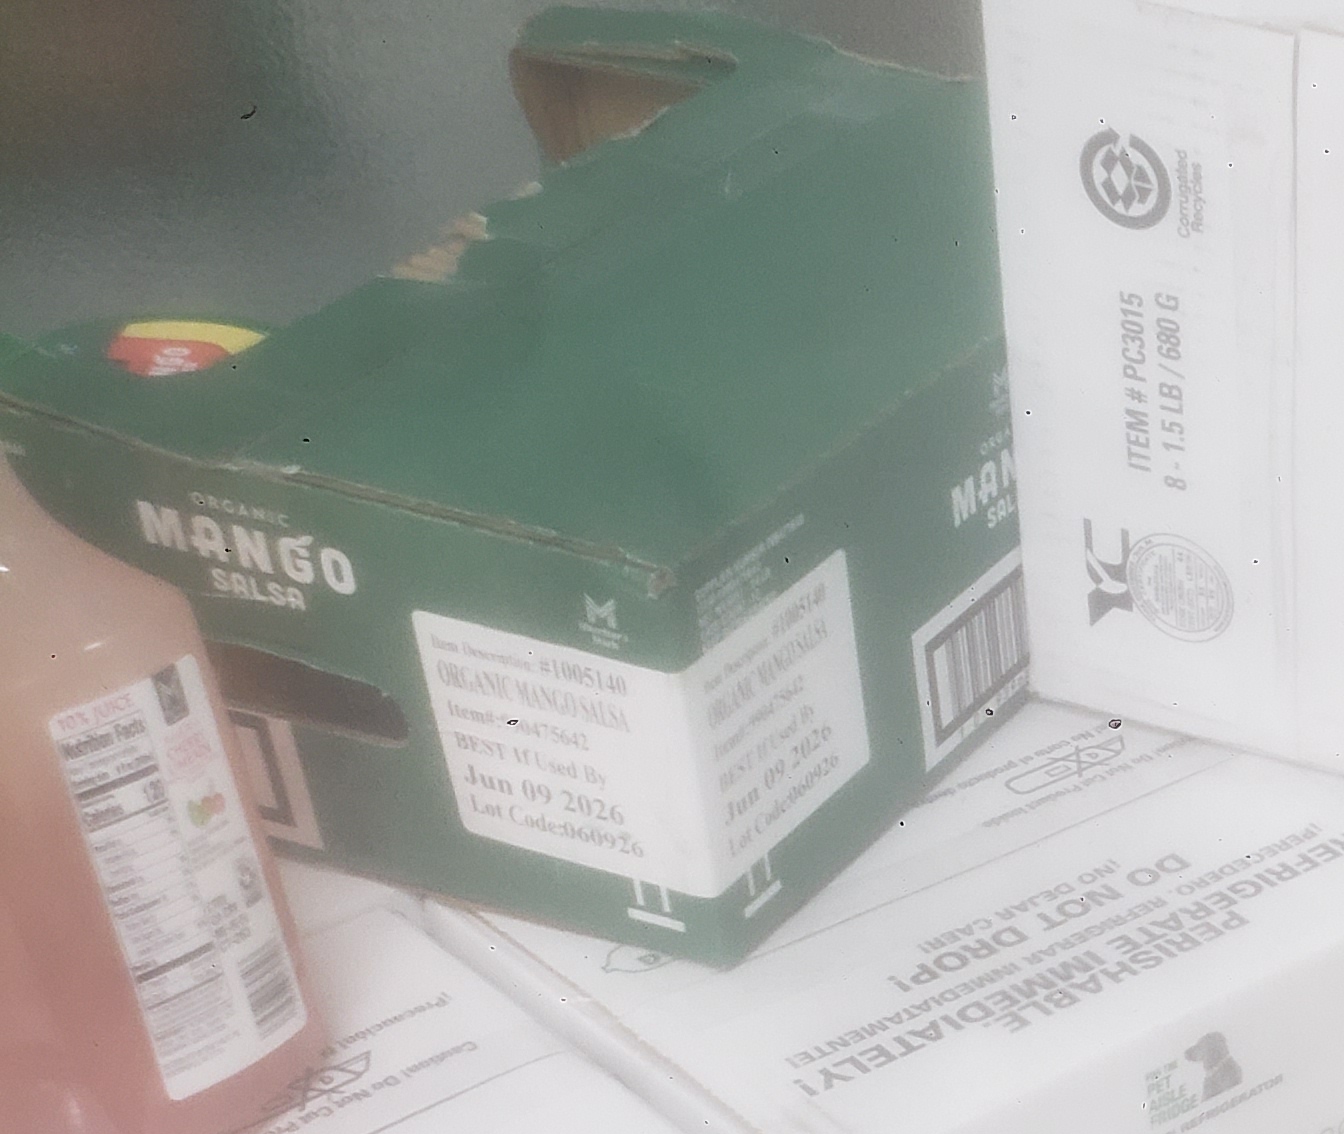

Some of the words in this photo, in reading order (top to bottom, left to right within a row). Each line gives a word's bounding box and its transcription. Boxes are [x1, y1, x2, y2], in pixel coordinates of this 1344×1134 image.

[1176, 149, 1190, 239] Corrugated
[1191, 162, 1206, 234] Recycles
[1155, 292, 1180, 312] G
[1120, 291, 1147, 383] PC3015
[1156, 318, 1181, 361] 680
[1127, 387, 1148, 404] #
[1158, 362, 1185, 381] /
[1159, 382, 1184, 415] LB
[1125, 404, 1152, 473] ITEM
[1160, 419, 1187, 453] 1.5
[951, 448, 1017, 528] MAN
[1164, 474, 1187, 491] 8
[189, 491, 290, 528] ORGANIC
[137, 499, 356, 595] MANGO
[211, 568, 306, 611] SALSA
[437, 658, 514, 697] ORGANIC
[516, 681, 577, 715] MANGO
[576, 697, 630, 733] SALSA
[539, 658, 627, 696] #1005140
[455, 733, 506, 760] BEST
[533, 751, 578, 781] Used
[583, 767, 606, 790] By
[724, 785, 761, 827] Jun
[763, 754, 787, 789] 09
[791, 724, 833, 768] 2026
[464, 764, 513, 796] Jun
[521, 780, 552, 806] 09
[564, 790, 625, 826] 2026
[470, 799, 502, 818] Lot
[1127, 852, 1192, 887] DO
[1169, 822, 1323, 896] ¡PERECEDERO.
[996, 881, 1075, 921] DEJAR
[1037, 883, 1124, 933] NOT
[917, 917, 993, 954] CAER!
[1023, 897, 1169, 966] REFRIGERAR
[886, 924, 1029, 994] DROP!
[981, 909, 1250, 1035] PERISHABLE.
[784, 960, 1022, 1069] INMEDIATAMENTE!
[792, 950, 1107, 1097] IMMEDIATELY!
[1147, 1076, 1172, 1099] PET
[1149, 1098, 1199, 1130] FRIDGE
